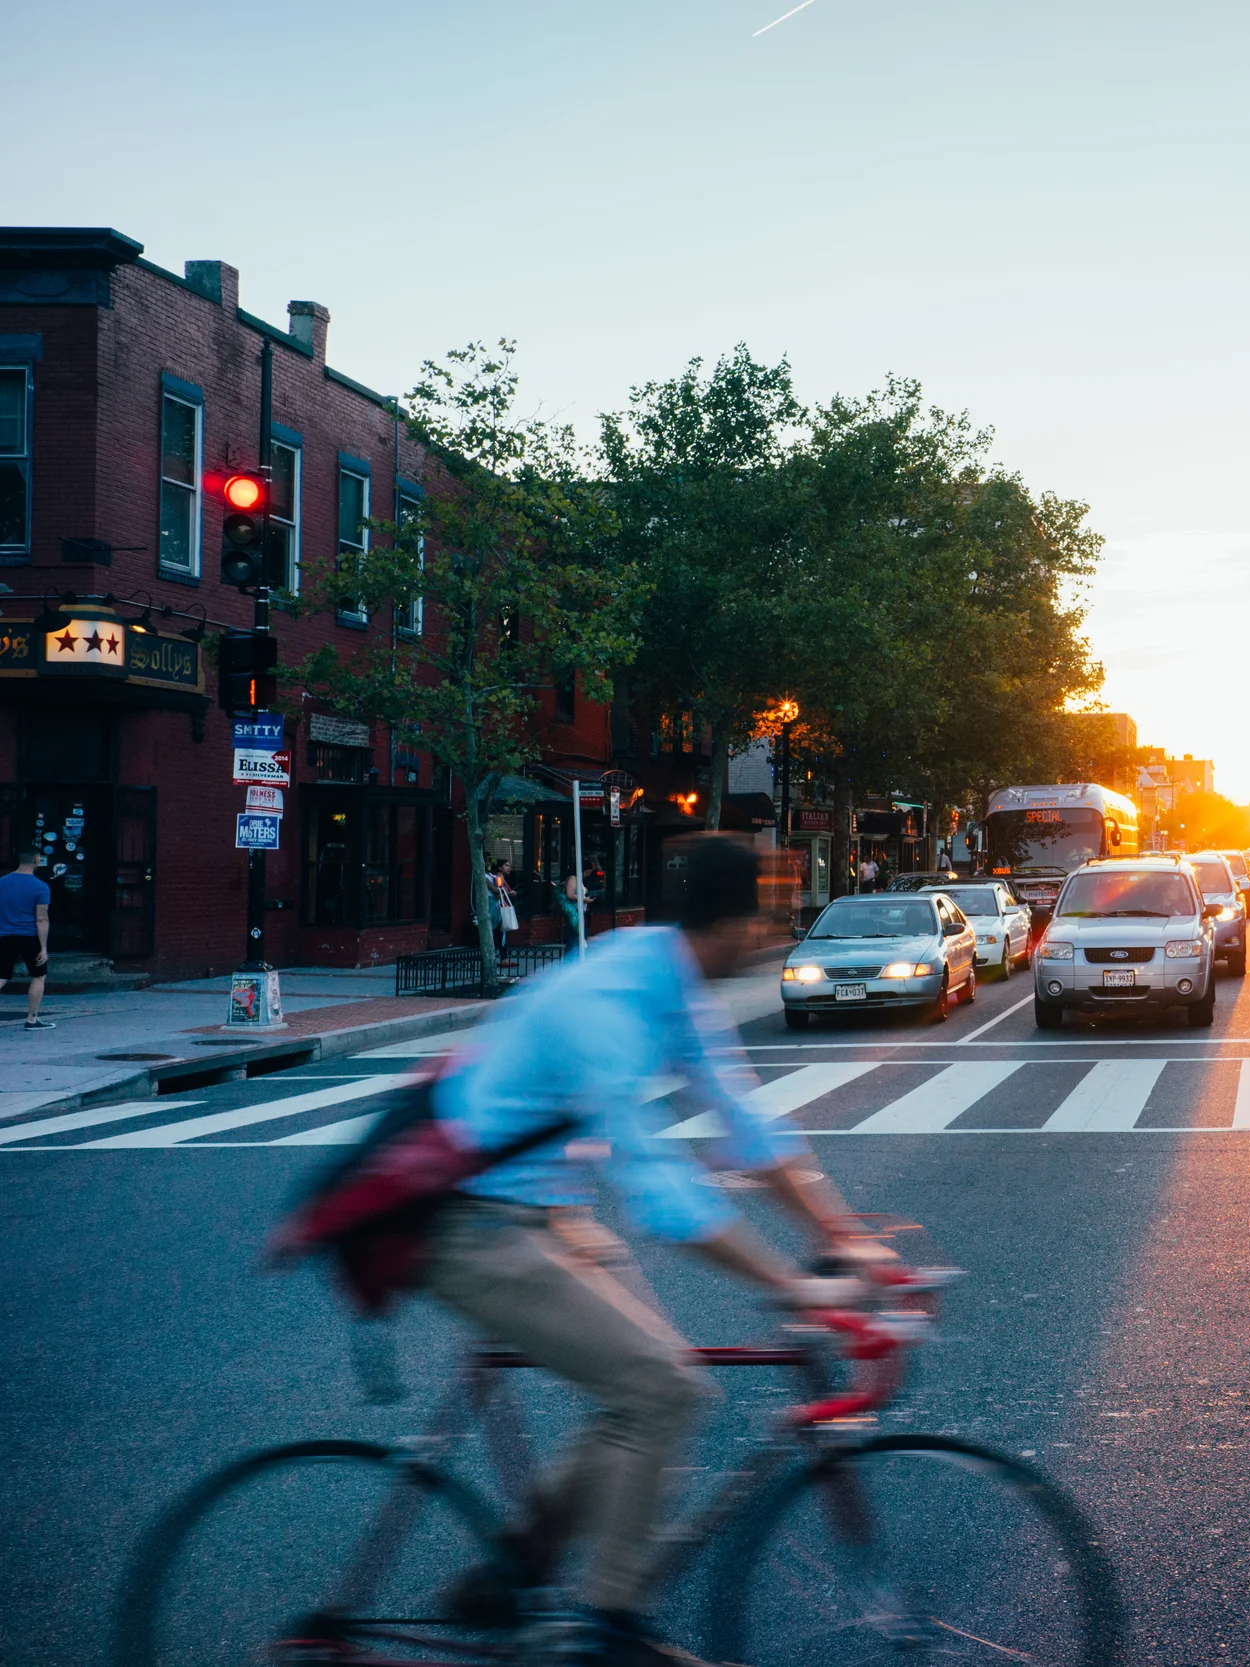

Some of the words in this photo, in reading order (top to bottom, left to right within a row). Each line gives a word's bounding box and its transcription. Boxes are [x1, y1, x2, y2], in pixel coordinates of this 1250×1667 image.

[234, 724, 281, 736] SMTTY
[238, 759, 286, 774] ELISSA
[802, 811, 829, 821] ITALIAN
[1026, 810, 1063, 823] SPECIAL
[239, 825, 276, 839] MSTERS
[1028, 890, 1058, 898] metrobu
